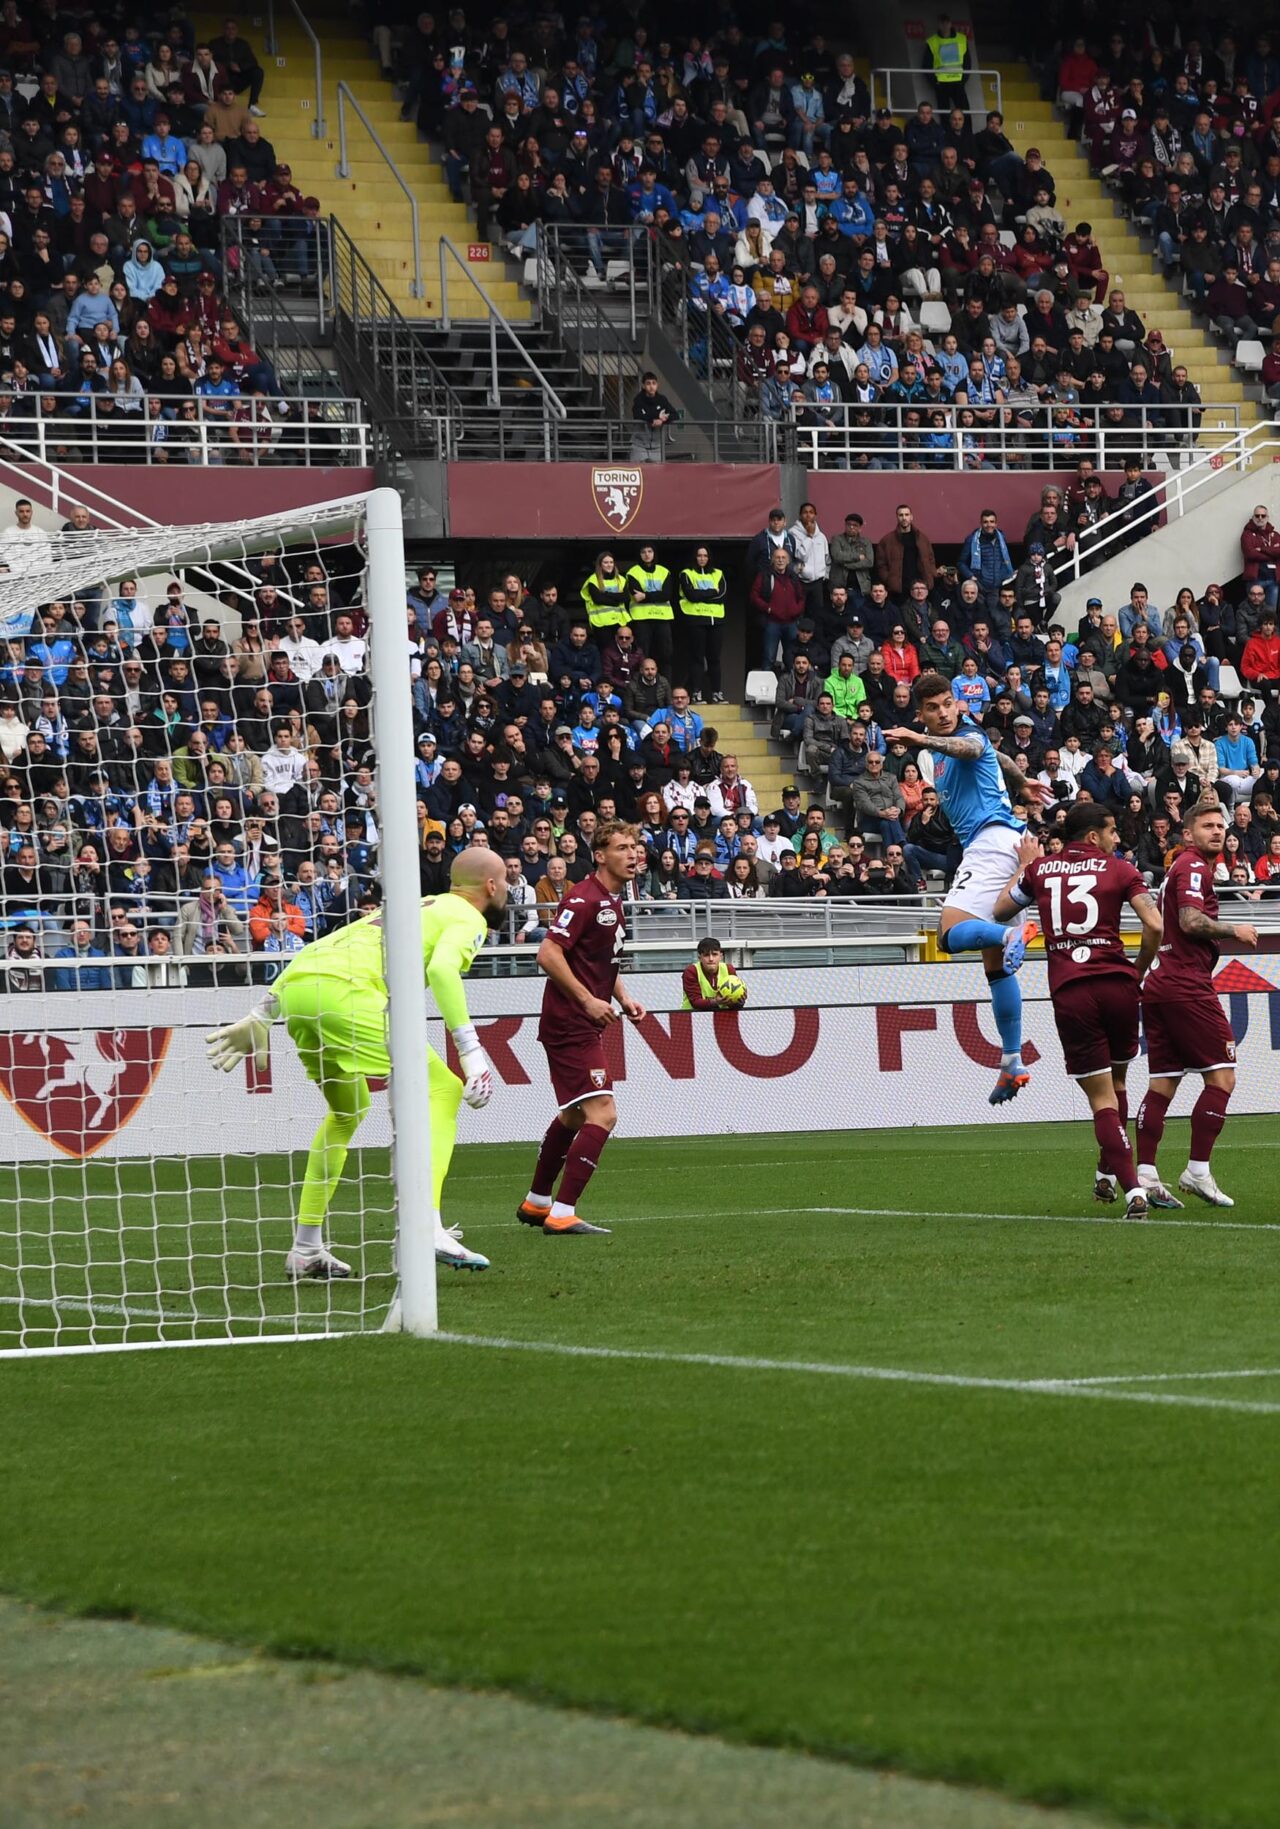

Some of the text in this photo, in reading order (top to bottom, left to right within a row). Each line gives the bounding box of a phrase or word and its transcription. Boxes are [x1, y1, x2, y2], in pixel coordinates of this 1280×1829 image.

[470, 247, 488, 258] 226
[597, 472, 637, 484] TORINO
[623, 487, 637, 497] FC
[1036, 859, 1107, 877] RODRIGUEZ
[1043, 874, 1099, 937] 13
